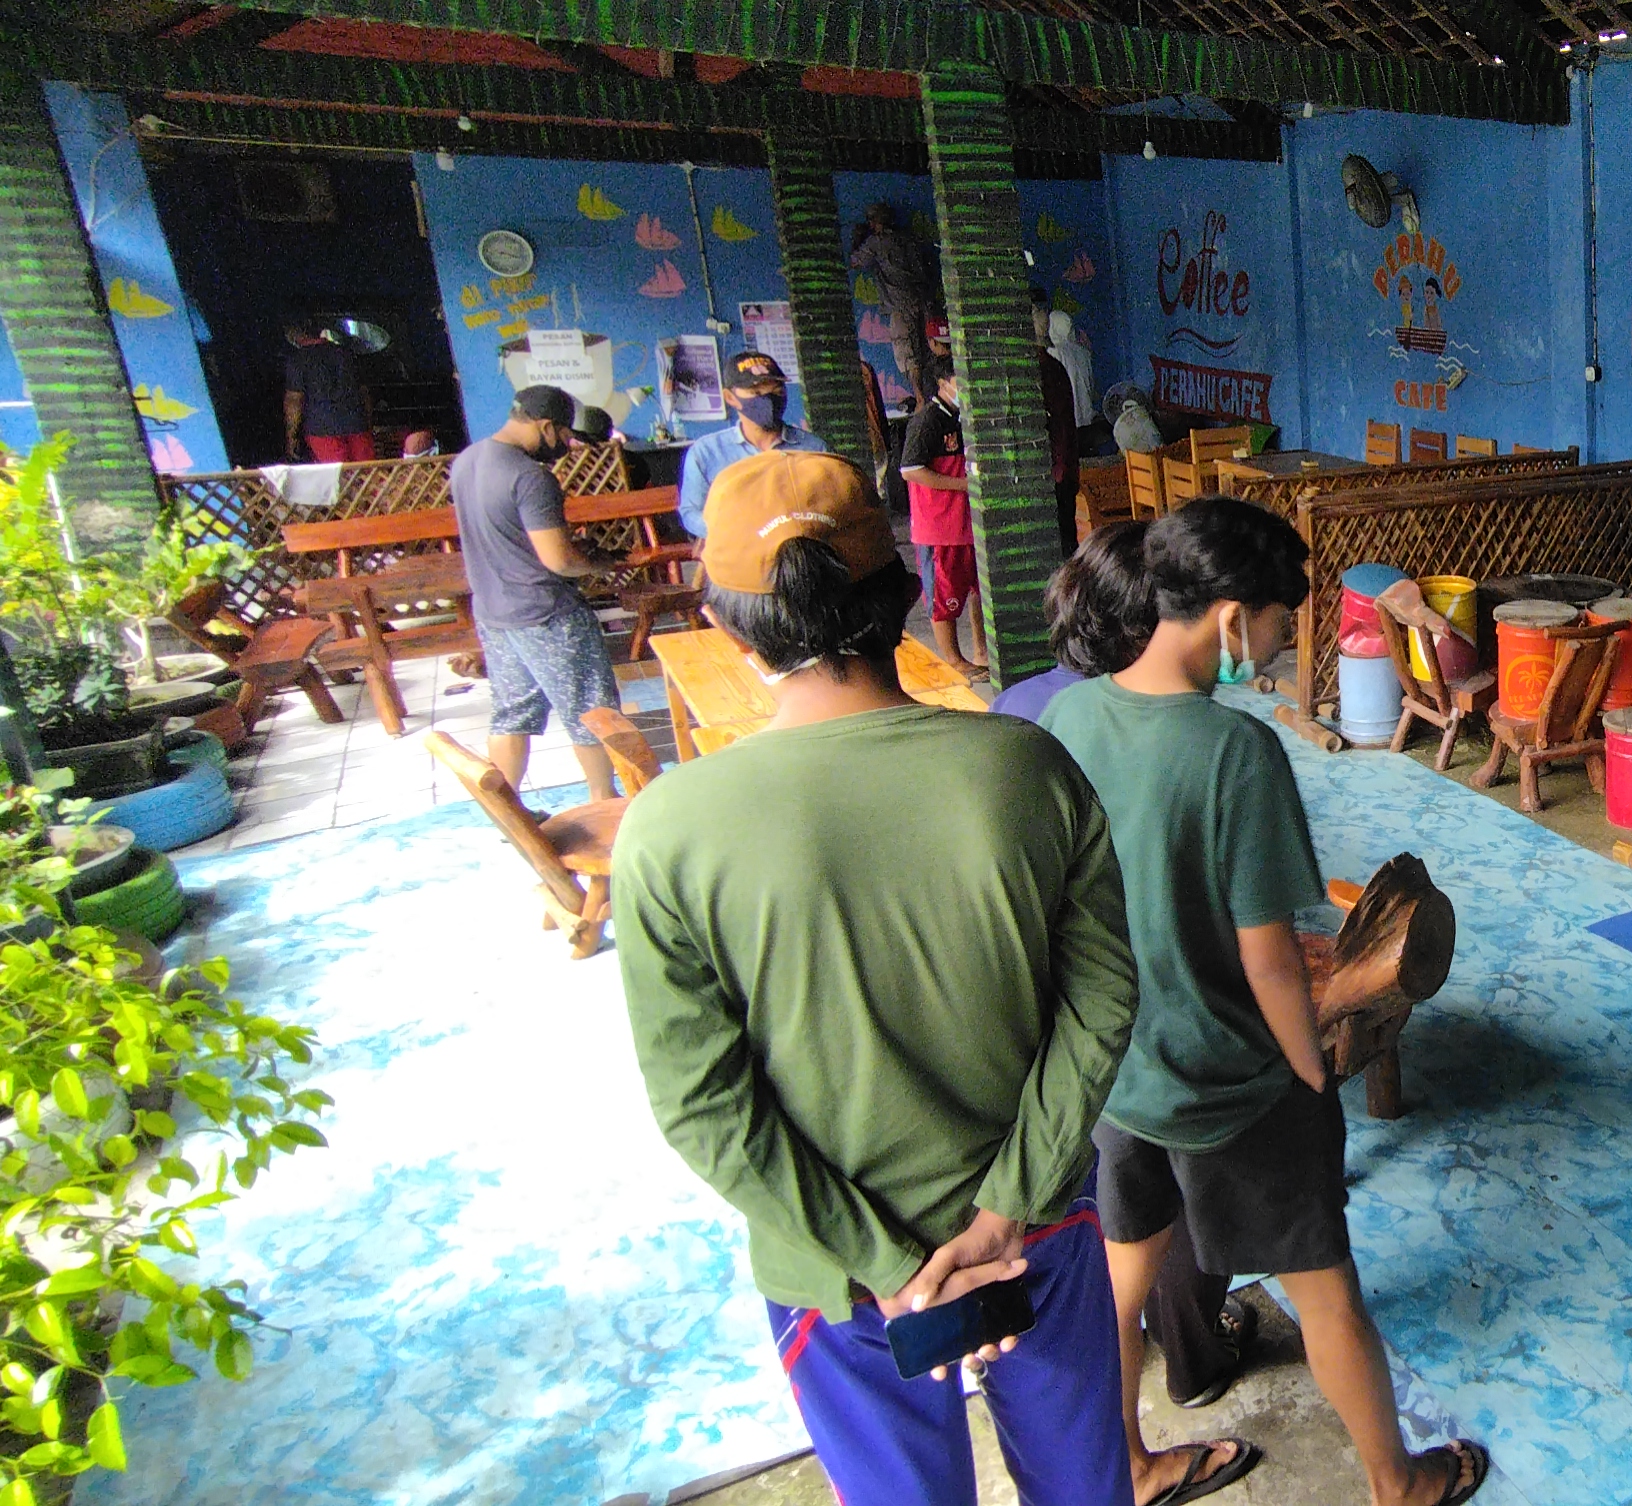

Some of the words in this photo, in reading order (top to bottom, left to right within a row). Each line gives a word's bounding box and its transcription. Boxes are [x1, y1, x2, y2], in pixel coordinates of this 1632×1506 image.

[1157, 209, 1250, 316] Coffee
[538, 359, 570, 369] PESAN
[1160, 366, 1216, 412] PERAHU
[1218, 375, 1265, 421] CAFE
